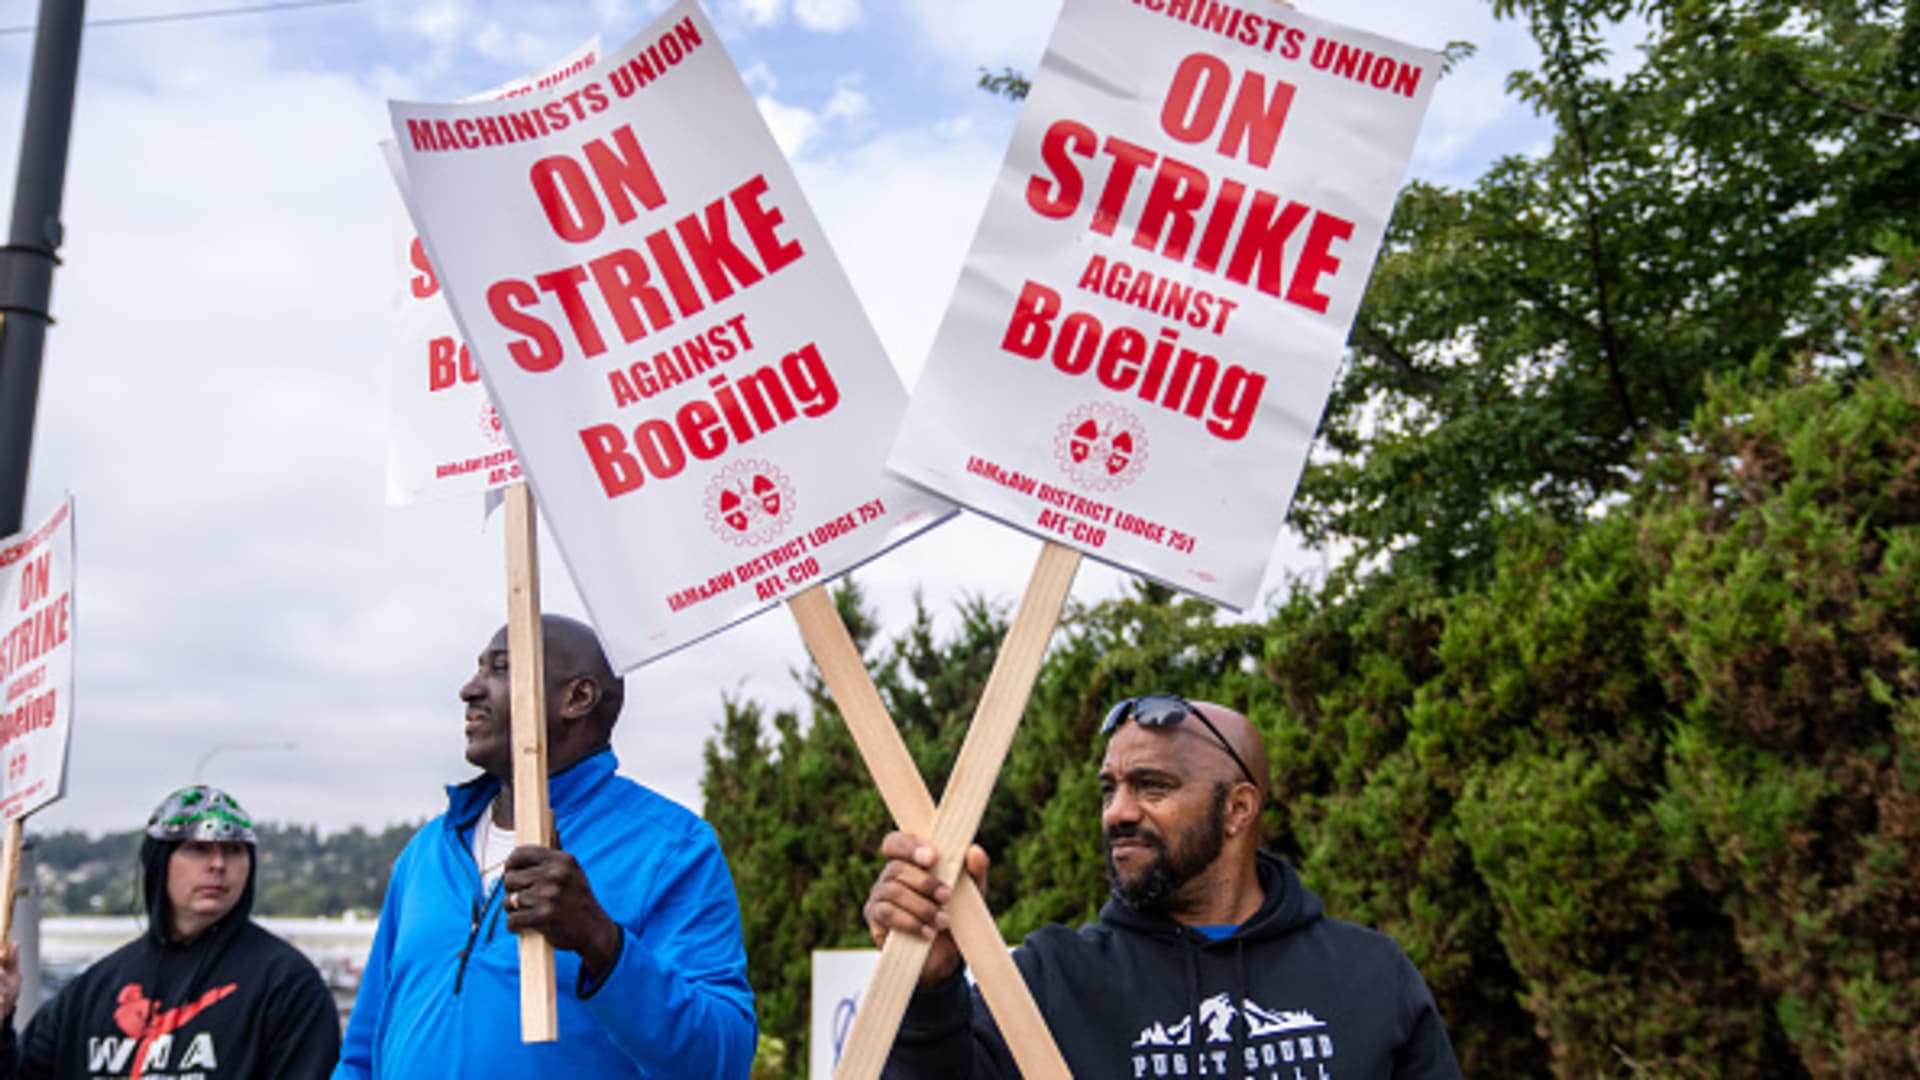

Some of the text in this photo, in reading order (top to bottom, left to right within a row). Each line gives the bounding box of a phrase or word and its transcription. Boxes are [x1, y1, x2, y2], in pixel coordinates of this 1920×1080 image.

[407, 15, 703, 152] MACHINISTS UNION
[1160, 52, 1298, 170] ON
[1310, 37, 1423, 98] UNION
[530, 123, 667, 244] ON
[1025, 118, 1356, 315] STRIKE
[485, 173, 805, 373] STRIKE
[1077, 253, 1239, 336] AGAINST
[607, 313, 754, 408] AGAINST
[1000, 278, 1268, 442] Boeing
[578, 342, 840, 498] Boeing
[735, 536, 808, 584] DISTRICT
[807, 512, 859, 548] LODGE
[857, 498, 886, 525] 751
[1037, 483, 1114, 523] DISTRICT
[1114, 510, 1166, 545] LODGE
[1166, 530, 1196, 554] 751
[1037, 508, 1107, 548] AFL-CIO
[19, 549, 51, 612] ON
[754, 556, 821, 602] AFL-CIO
[1244, 1034, 1334, 1070] SOUND
